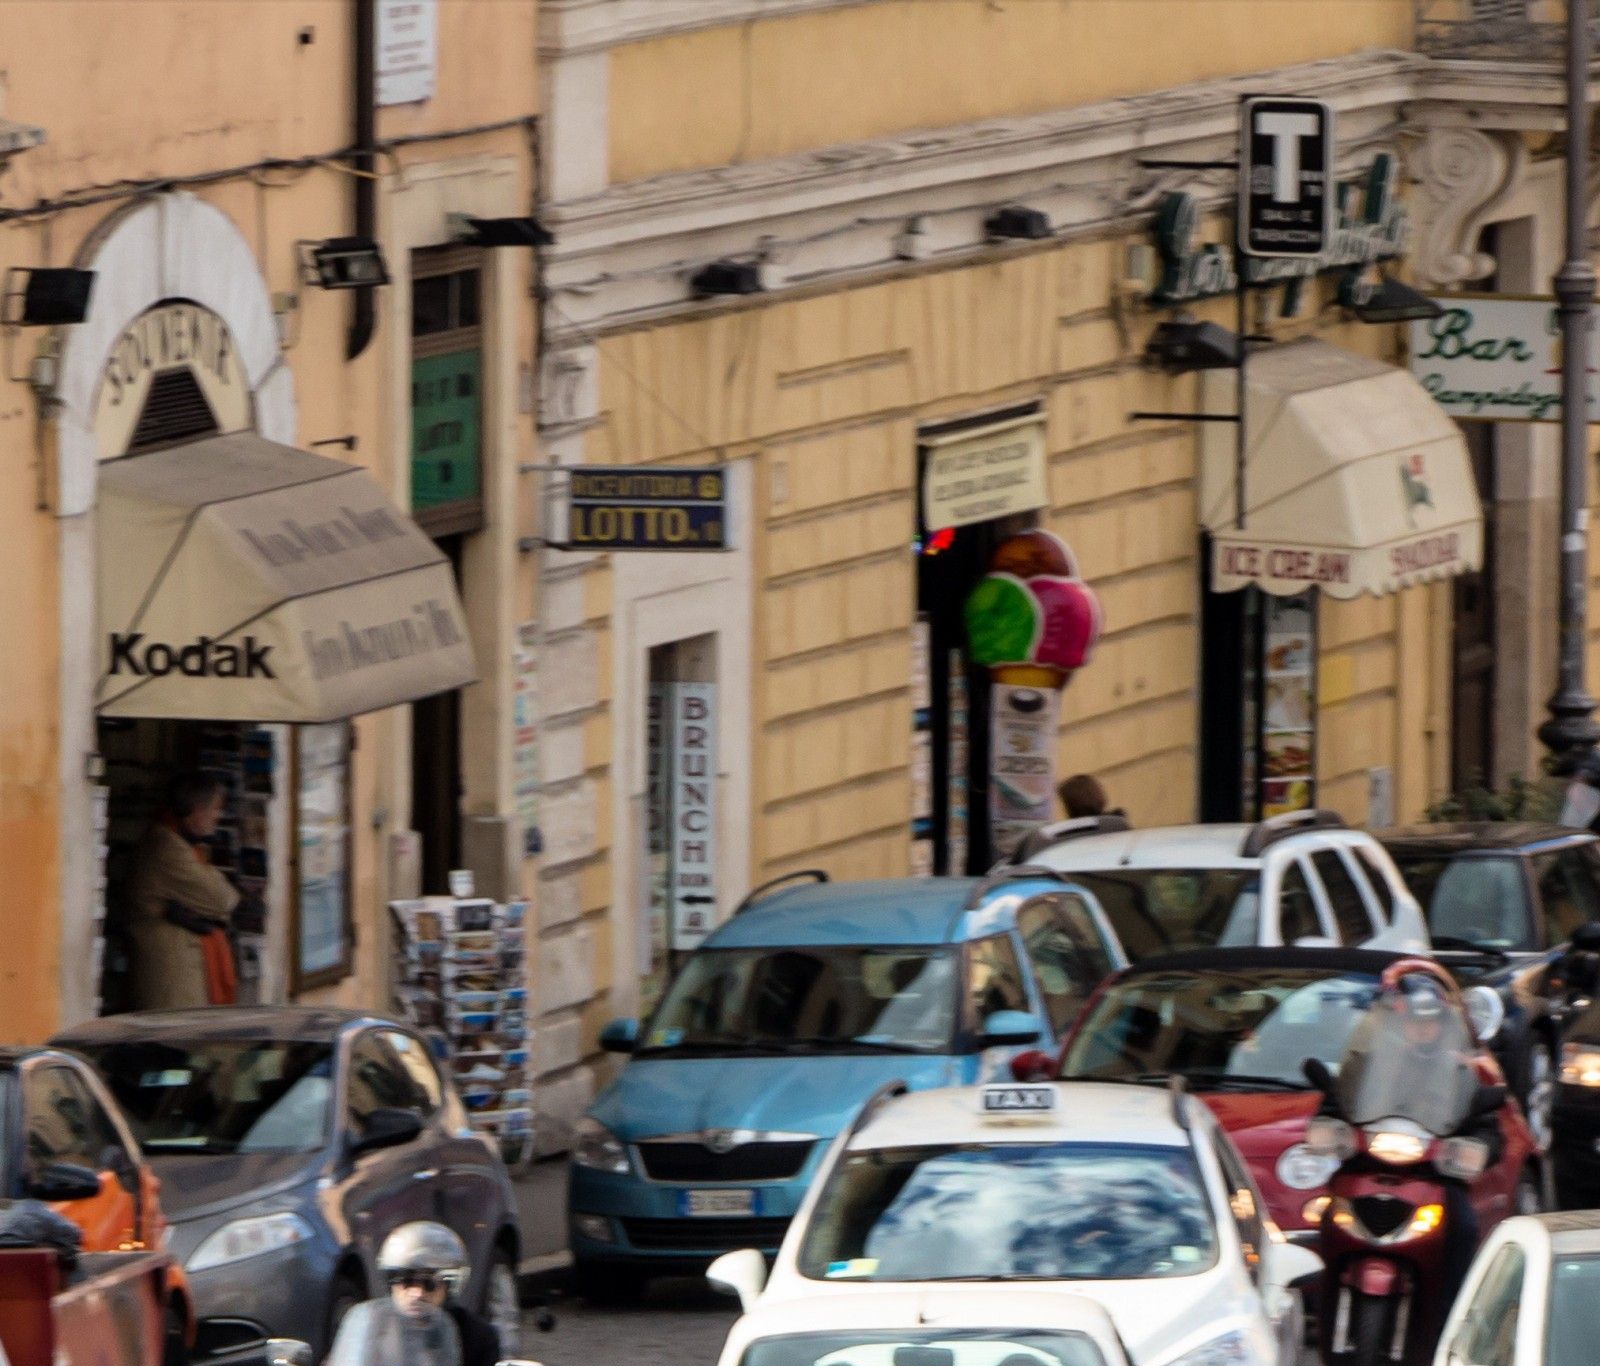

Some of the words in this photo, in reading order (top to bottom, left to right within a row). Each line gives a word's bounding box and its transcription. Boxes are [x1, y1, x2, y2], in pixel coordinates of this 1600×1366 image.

[1255, 112, 1320, 203] T
[1418, 308, 1533, 362] Bar
[571, 506, 690, 543] LOTTO
[1221, 547, 1260, 577] ICE
[1264, 549, 1351, 584] CREAM
[107, 632, 281, 680] Kodak
[681, 696, 710, 864] BRUNCH
[984, 1089, 1055, 1110] TAXI
